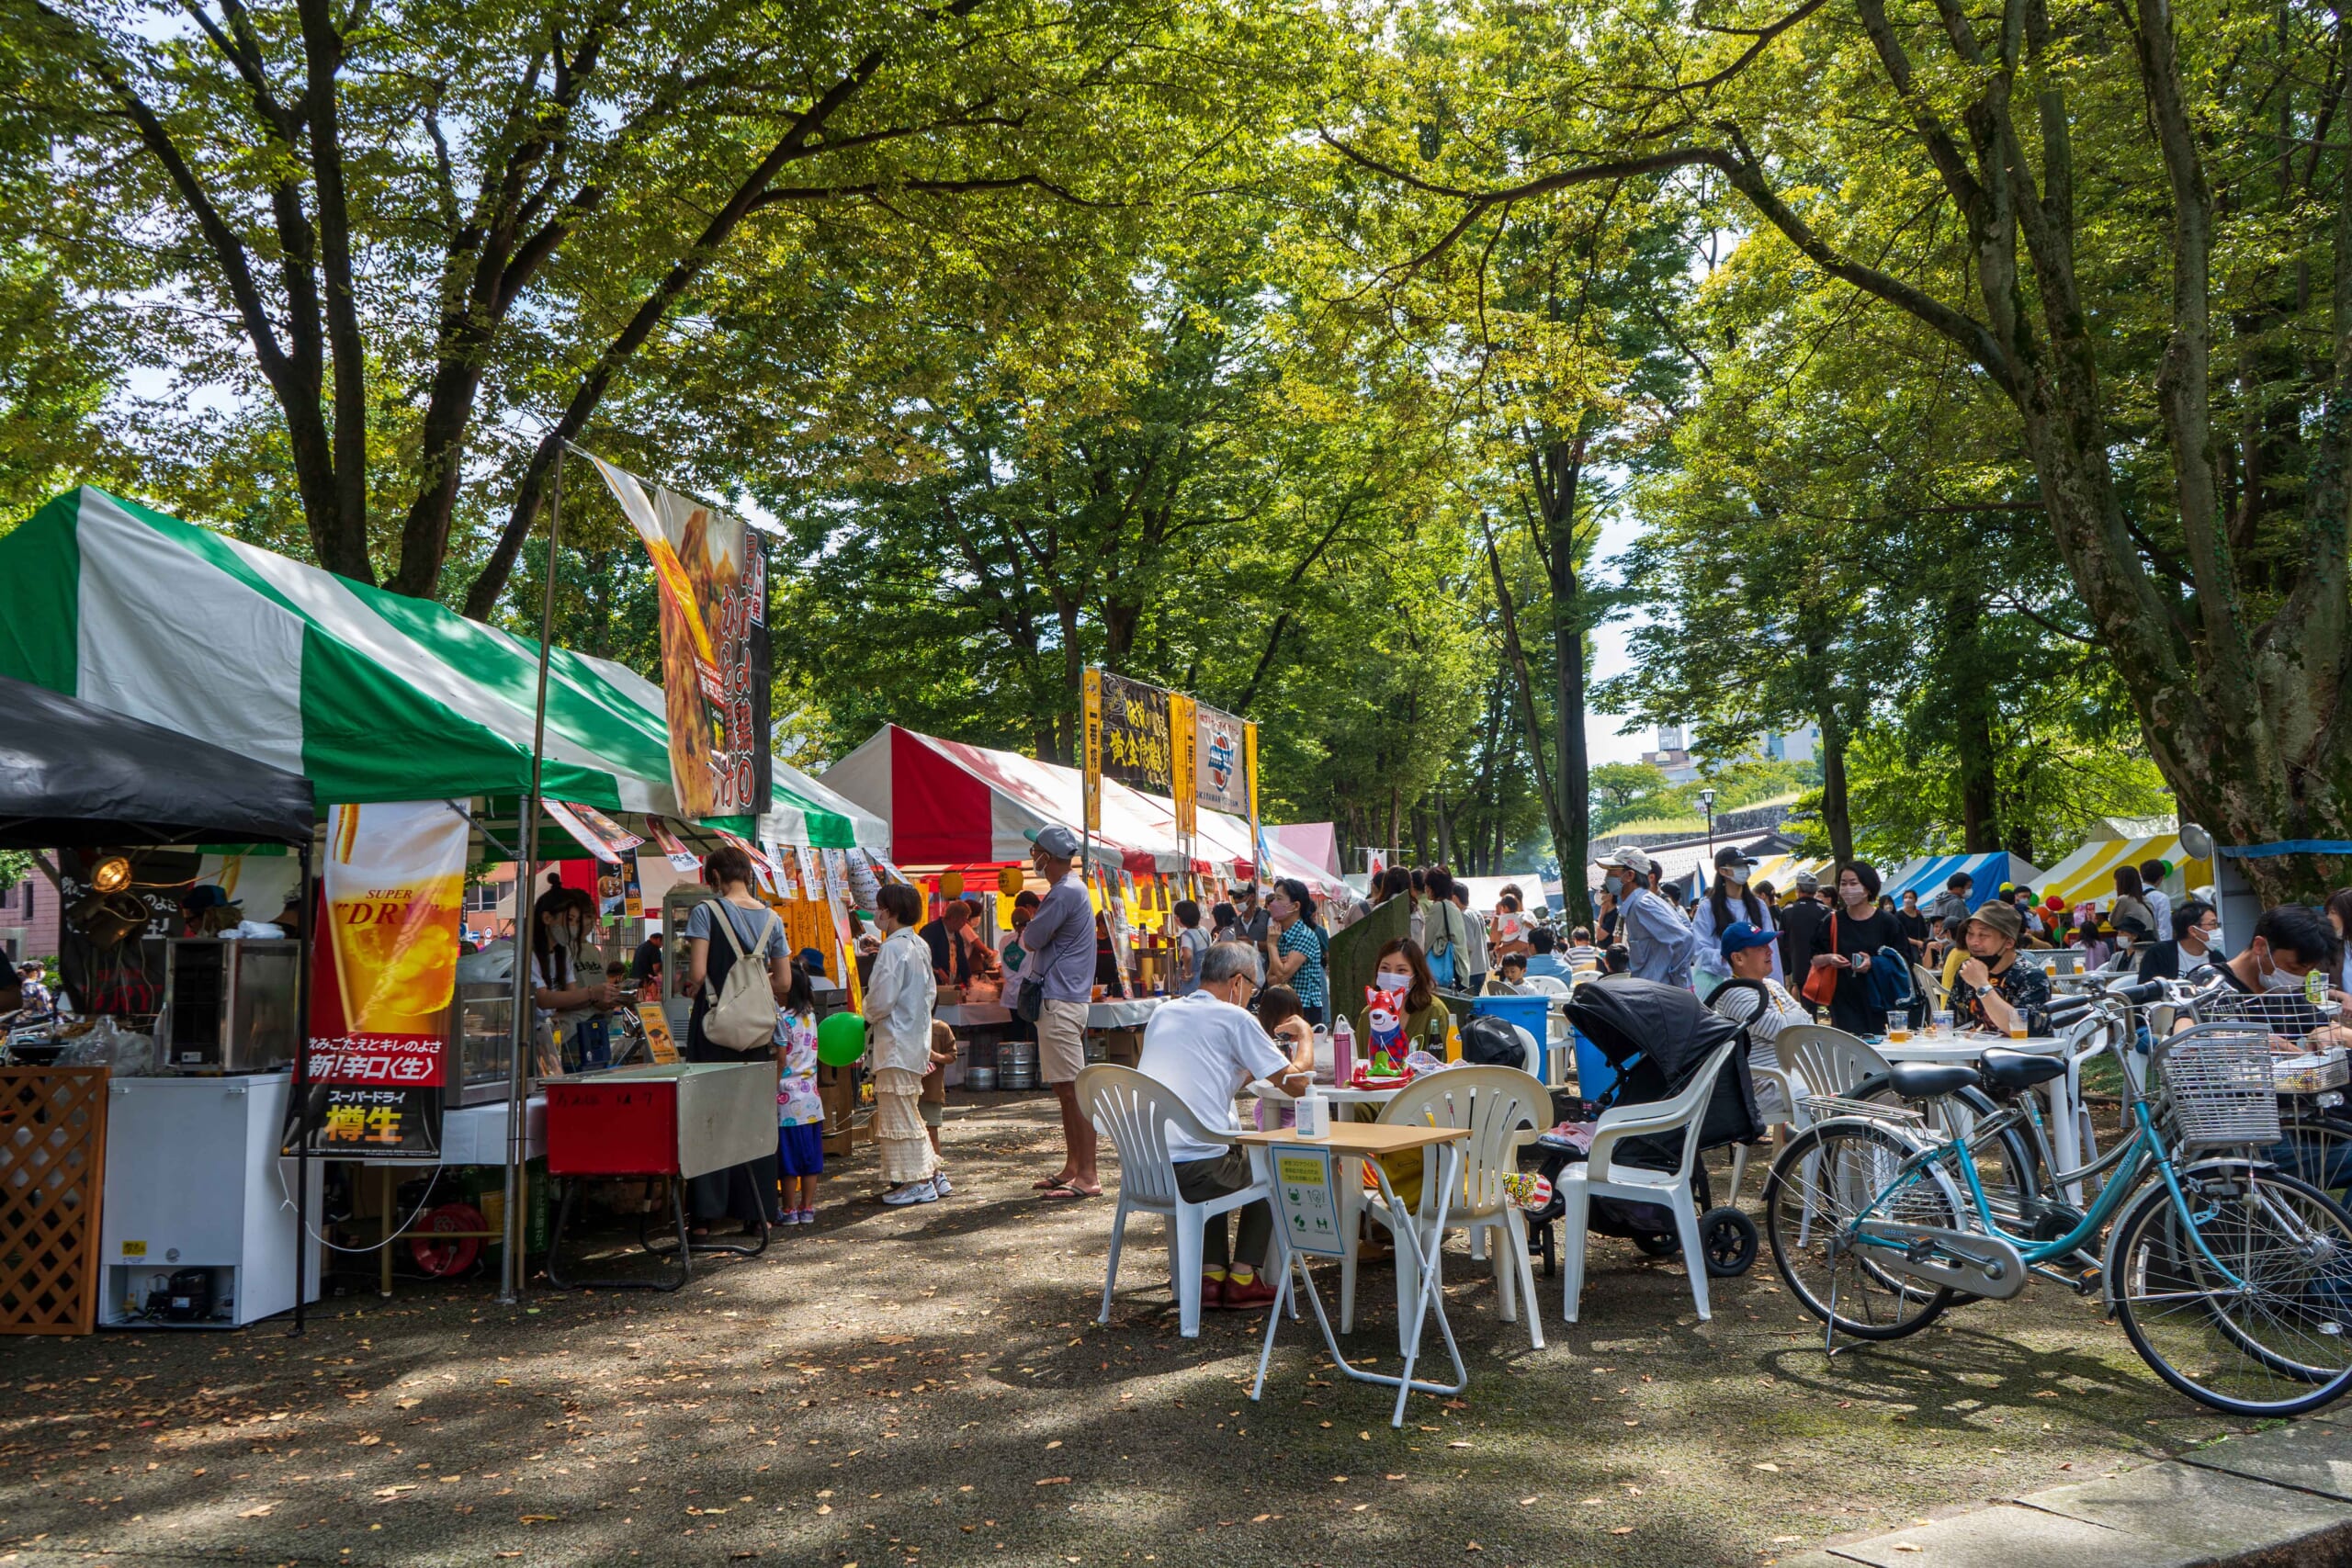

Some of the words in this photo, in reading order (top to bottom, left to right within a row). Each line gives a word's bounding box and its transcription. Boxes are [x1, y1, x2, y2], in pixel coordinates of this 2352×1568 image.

[367, 889, 413, 899] SUPER
[329, 1090, 406, 1103] スーパードライ
[323, 1104, 403, 1142] 樽生
